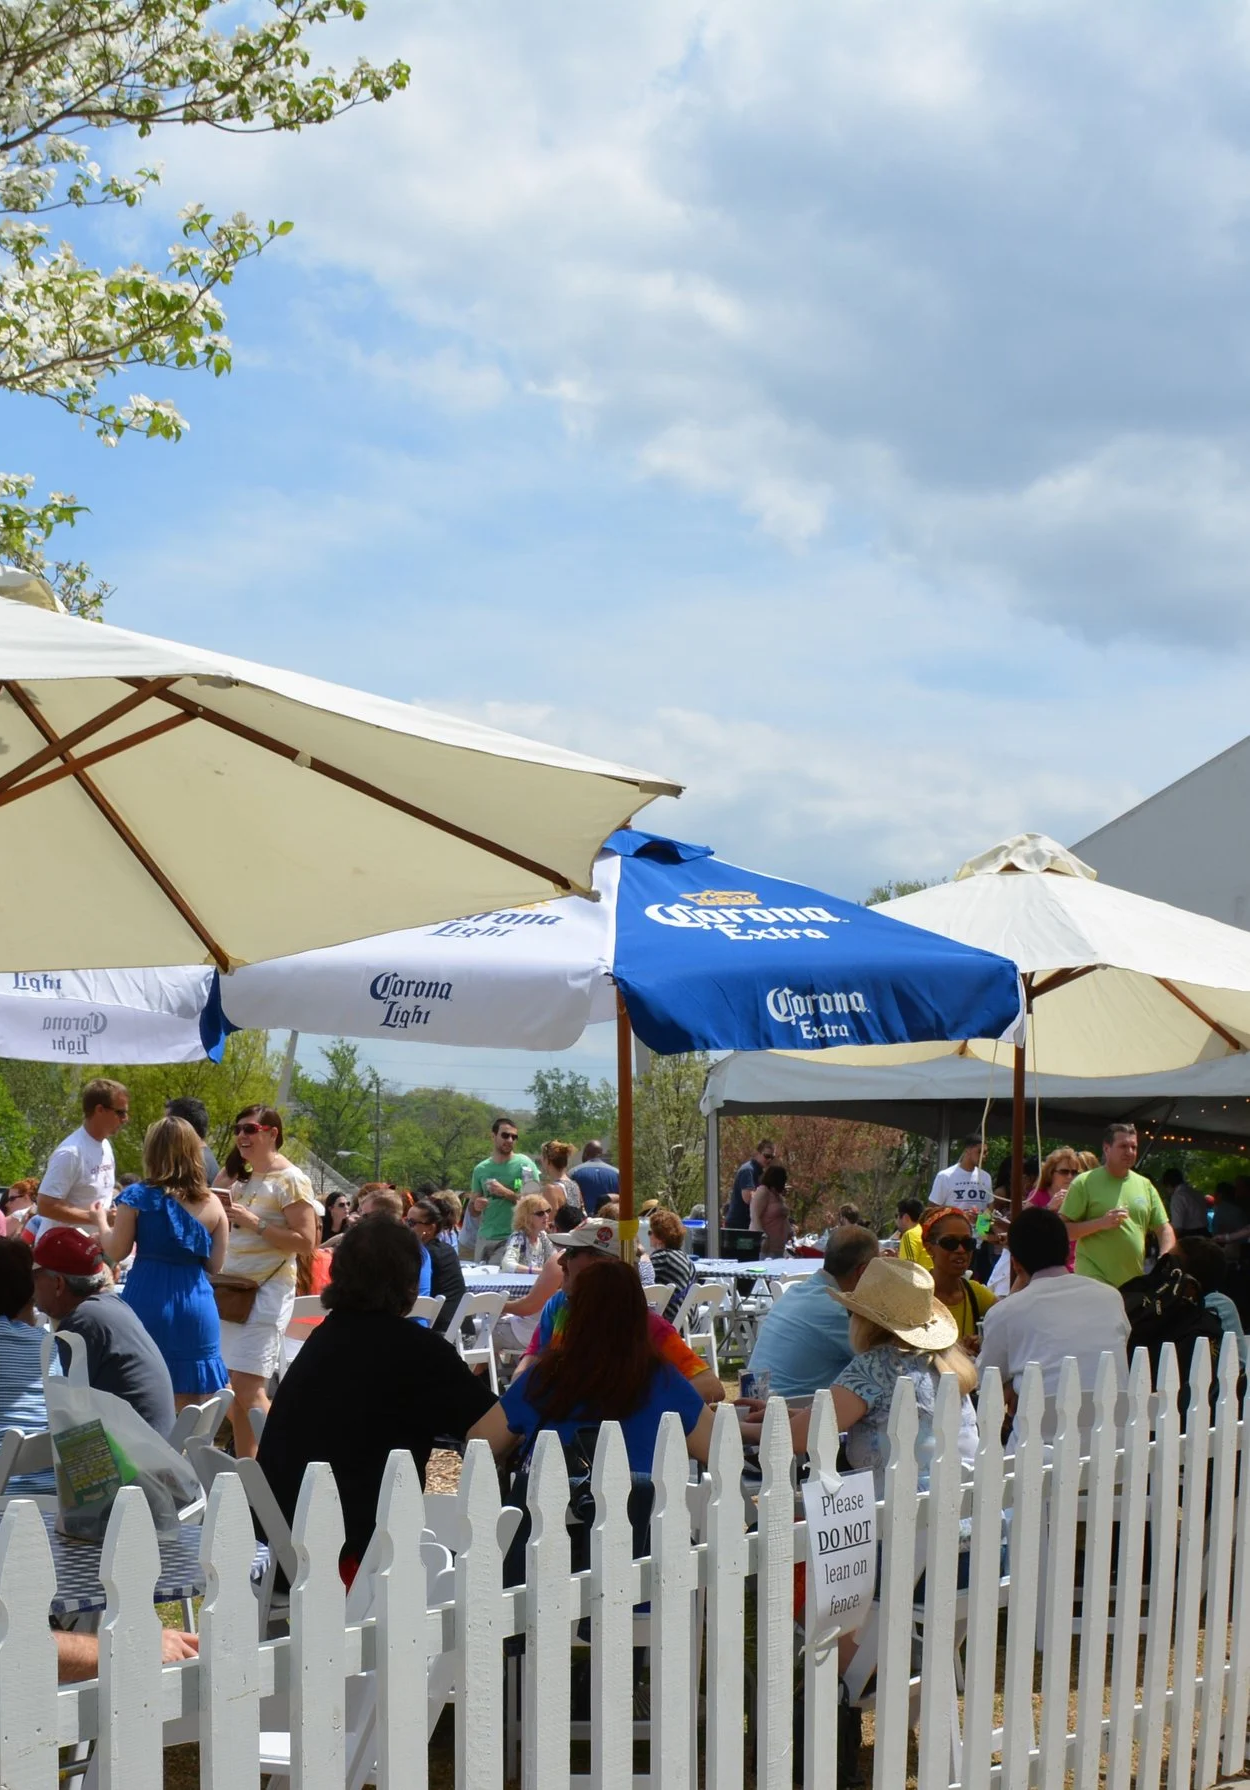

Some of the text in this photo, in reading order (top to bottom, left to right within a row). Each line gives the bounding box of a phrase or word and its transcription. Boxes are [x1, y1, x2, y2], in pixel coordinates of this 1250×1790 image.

[454, 911, 564, 926] rona
[644, 903, 841, 930] Corona
[426, 921, 514, 938] Light
[714, 923, 830, 940] Extra
[13, 972, 62, 992] Light
[370, 972, 453, 1004] Corona
[380, 1001, 431, 1028] Light
[766, 987, 868, 1025] Corona
[799, 1020, 849, 1039] Extra
[954, 1189, 986, 1200] YOU
[821, 1492, 865, 1516] Please
[817, 1520, 872, 1551] DO NOT
[825, 1559, 868, 1585] lean on
[829, 1593, 861, 1616] fence.
